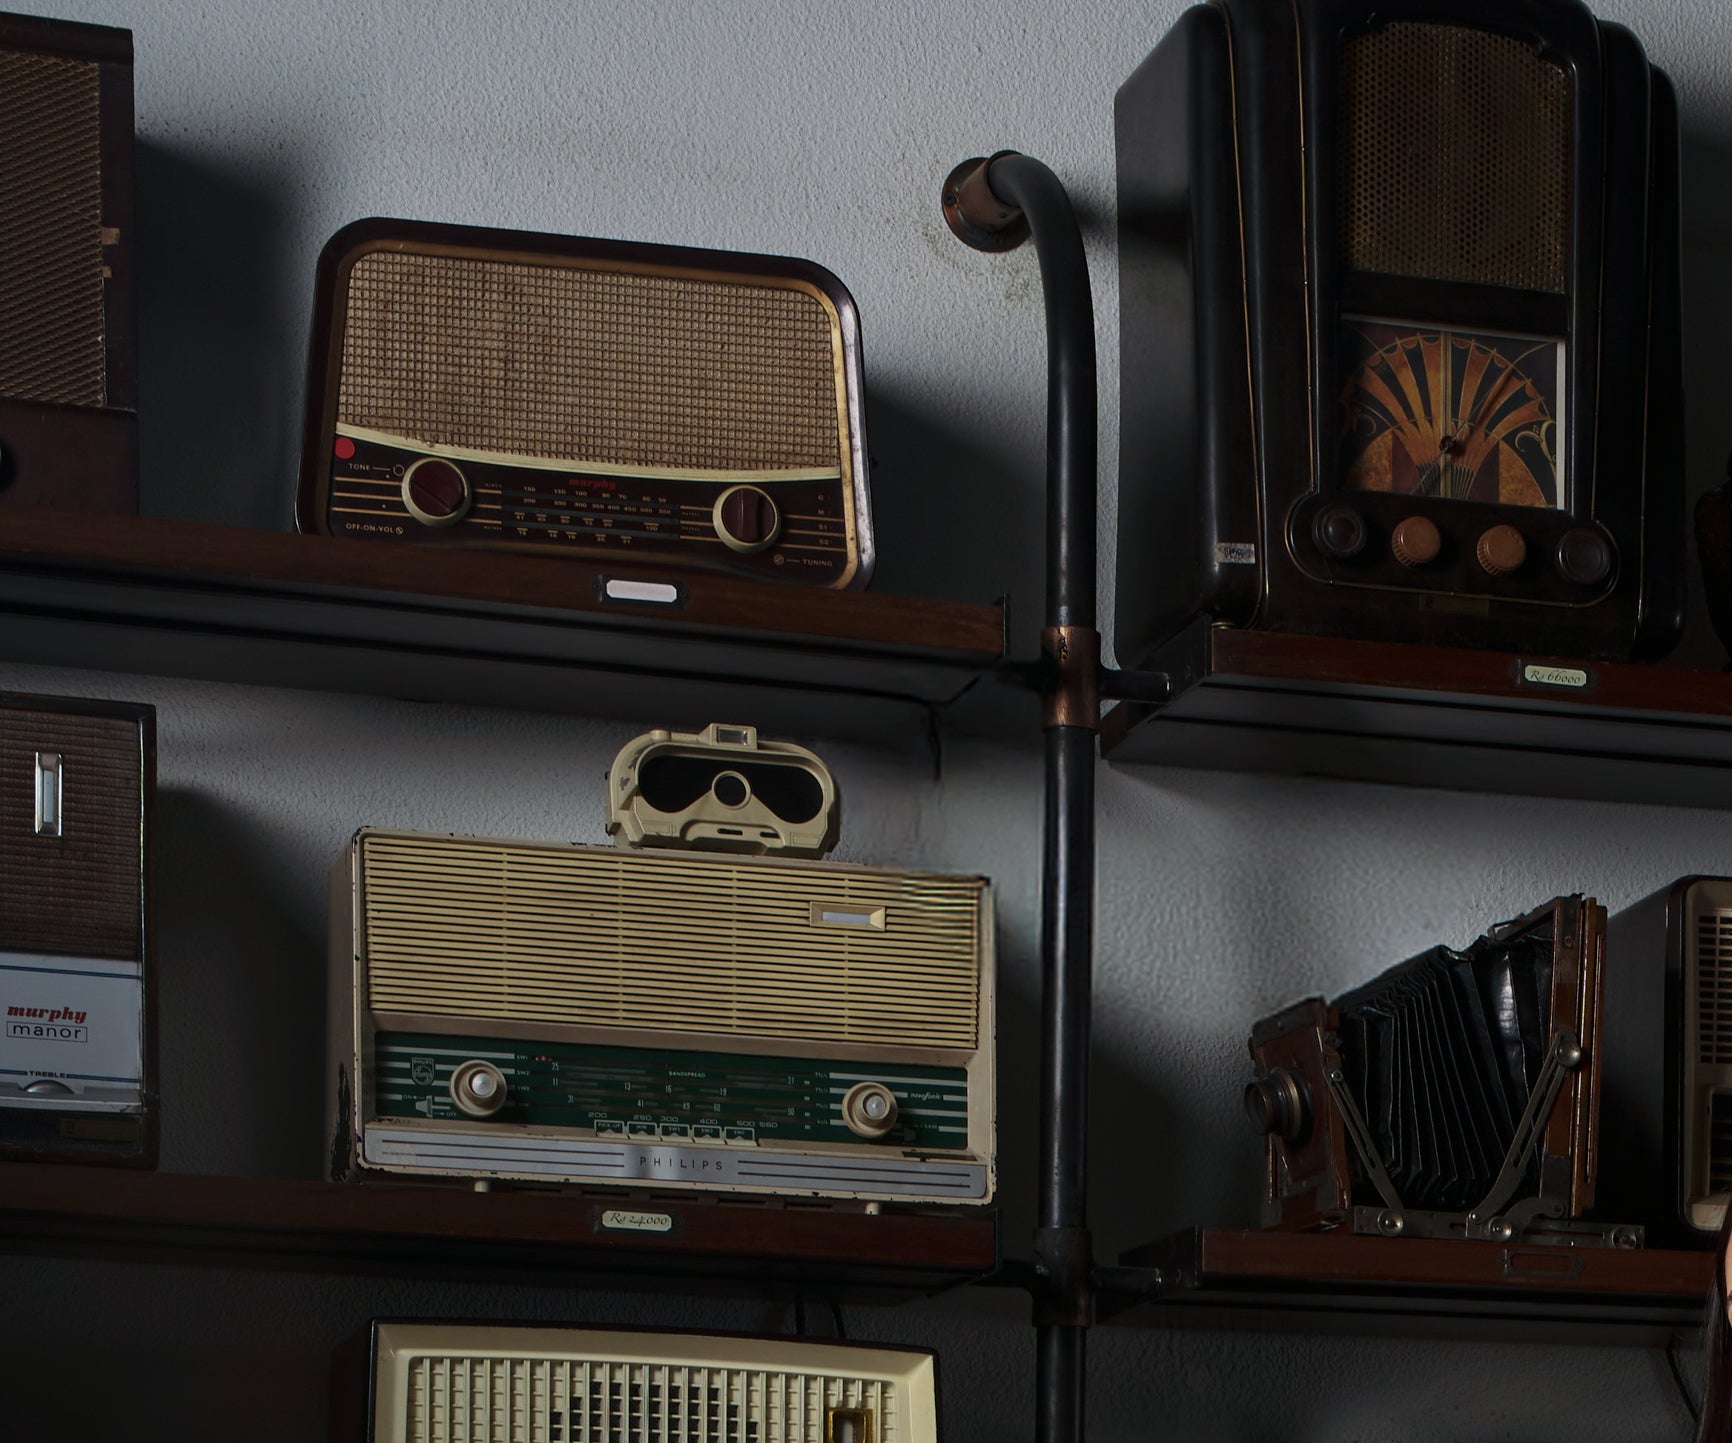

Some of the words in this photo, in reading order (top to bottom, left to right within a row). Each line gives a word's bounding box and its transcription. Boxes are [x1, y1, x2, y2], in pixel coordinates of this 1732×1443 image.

[349, 463, 371, 471] TONE
[569, 479, 617, 491] murphy
[801, 558, 833, 567] TUNING
[1547, 669, 1581, 684] 66000
[7, 1006, 87, 1024] murphy
[13, 1025, 82, 1039] manor
[28, 1071, 67, 1079] TREBLE
[787, 1077, 795, 1085] 31
[639, 1156, 723, 1170] PHILIPS
